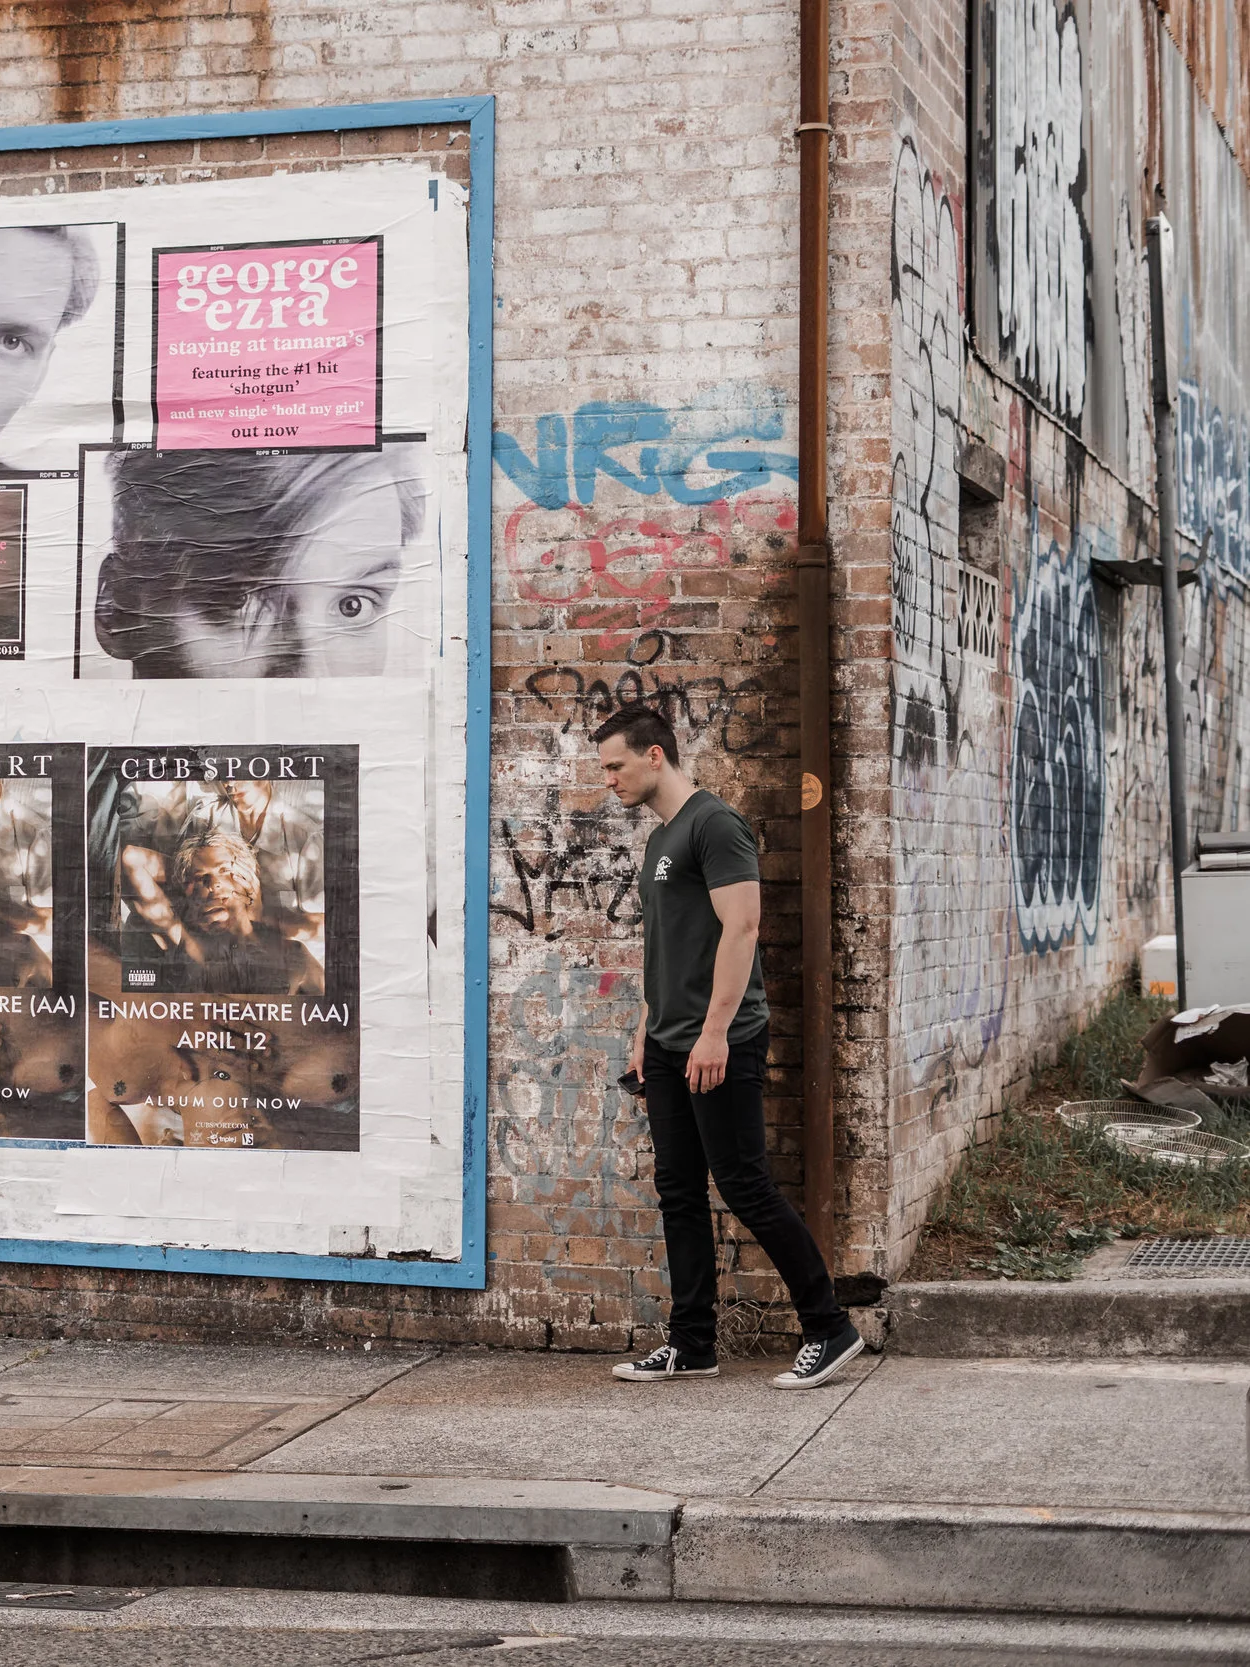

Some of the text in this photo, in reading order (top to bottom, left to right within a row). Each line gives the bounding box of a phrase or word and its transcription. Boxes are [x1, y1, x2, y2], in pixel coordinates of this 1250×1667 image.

[176, 256, 358, 312] george
[206, 294, 328, 331] ezra
[169, 338, 241, 358] staying
[247, 339, 267, 352] at
[192, 361, 338, 380] featuring the #1 hit
[170, 407, 194, 420] and
[198, 409, 224, 419] new
[228, 405, 267, 420] single
[310, 404, 331, 416] my
[232, 426, 299, 438] out now
[121, 756, 324, 781] CUB SPORT
[30, 995, 76, 1018] (AA)
[99, 1001, 349, 1026] ENMORE THEATRE (AA)
[177, 1031, 266, 1050] APRIL 12
[144, 1095, 301, 1110] ALBUM OUT NOW
